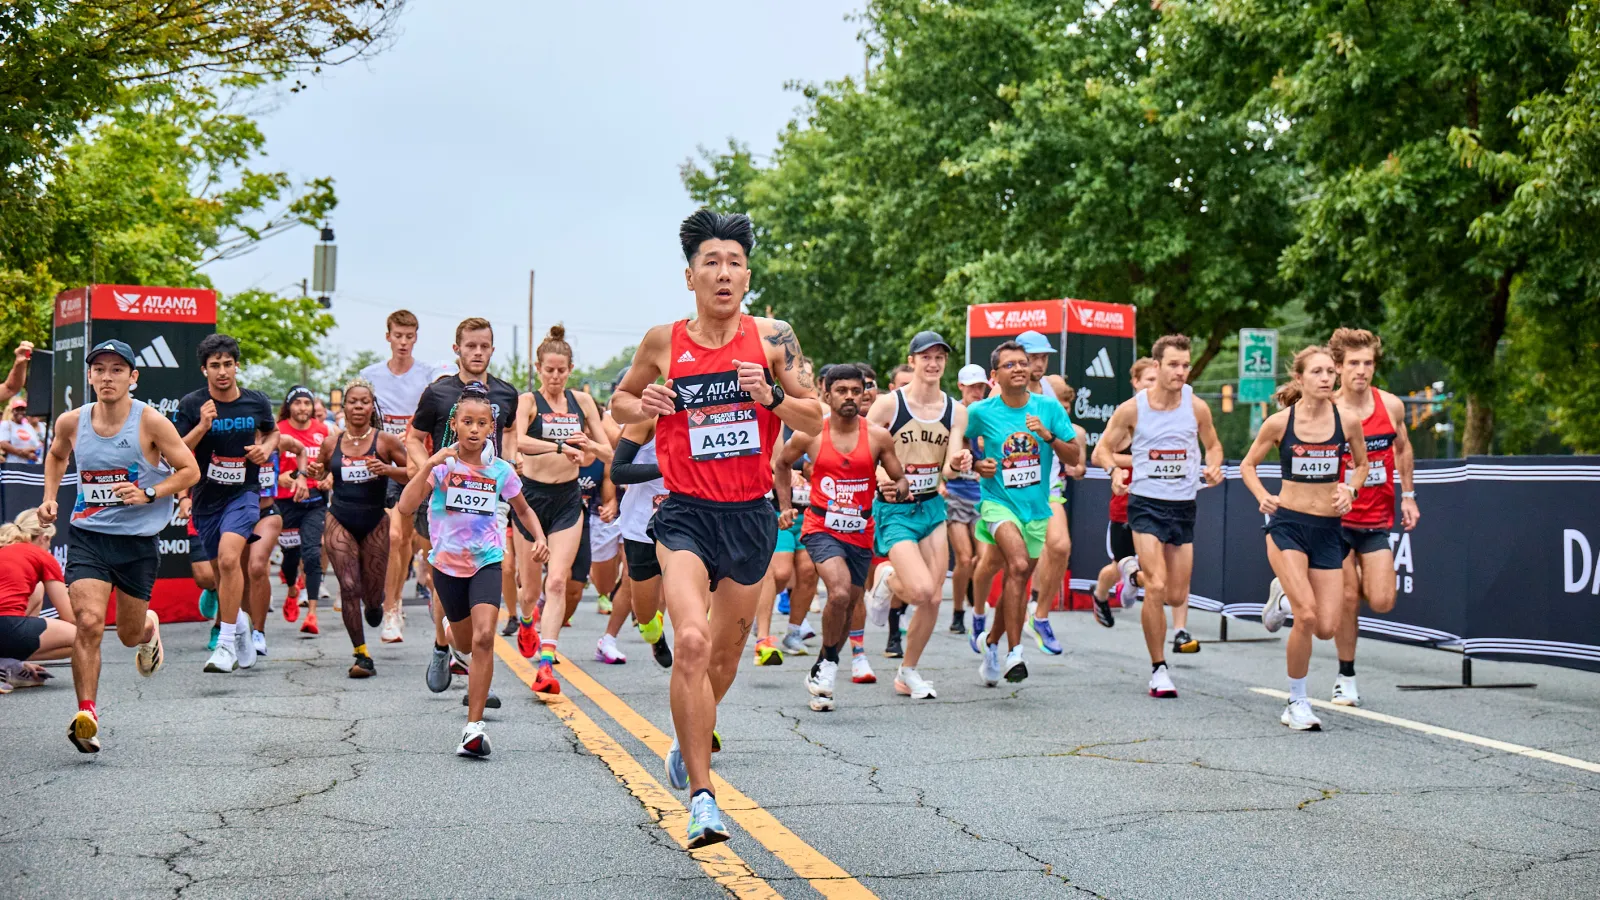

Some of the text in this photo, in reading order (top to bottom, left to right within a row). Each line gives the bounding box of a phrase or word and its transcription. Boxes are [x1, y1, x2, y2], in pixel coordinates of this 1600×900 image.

[142, 295, 197, 310] ATLANTA
[175, 308, 197, 316] CLUB
[1005, 309, 1048, 323] ATLANTA
[1093, 310, 1124, 325] ATLANTA
[706, 380, 742, 396] ATLA
[706, 392, 736, 402] TRACK
[737, 409, 753, 421] 5K
[211, 416, 255, 431] AIDEIA
[702, 430, 749, 449] A432
[900, 430, 918, 444] ST.
[1154, 464, 1182, 473] A429
[1300, 462, 1331, 472] A419
[114, 473, 127, 482] 5K
[211, 469, 242, 480] E2065
[1010, 471, 1037, 482] A270
[482, 483, 495, 492] 5K
[836, 482, 869, 493] RUNNING
[910, 478, 934, 487] A110
[91, 489, 121, 500] A17
[453, 493, 489, 507] A397
[831, 518, 862, 529] A163
